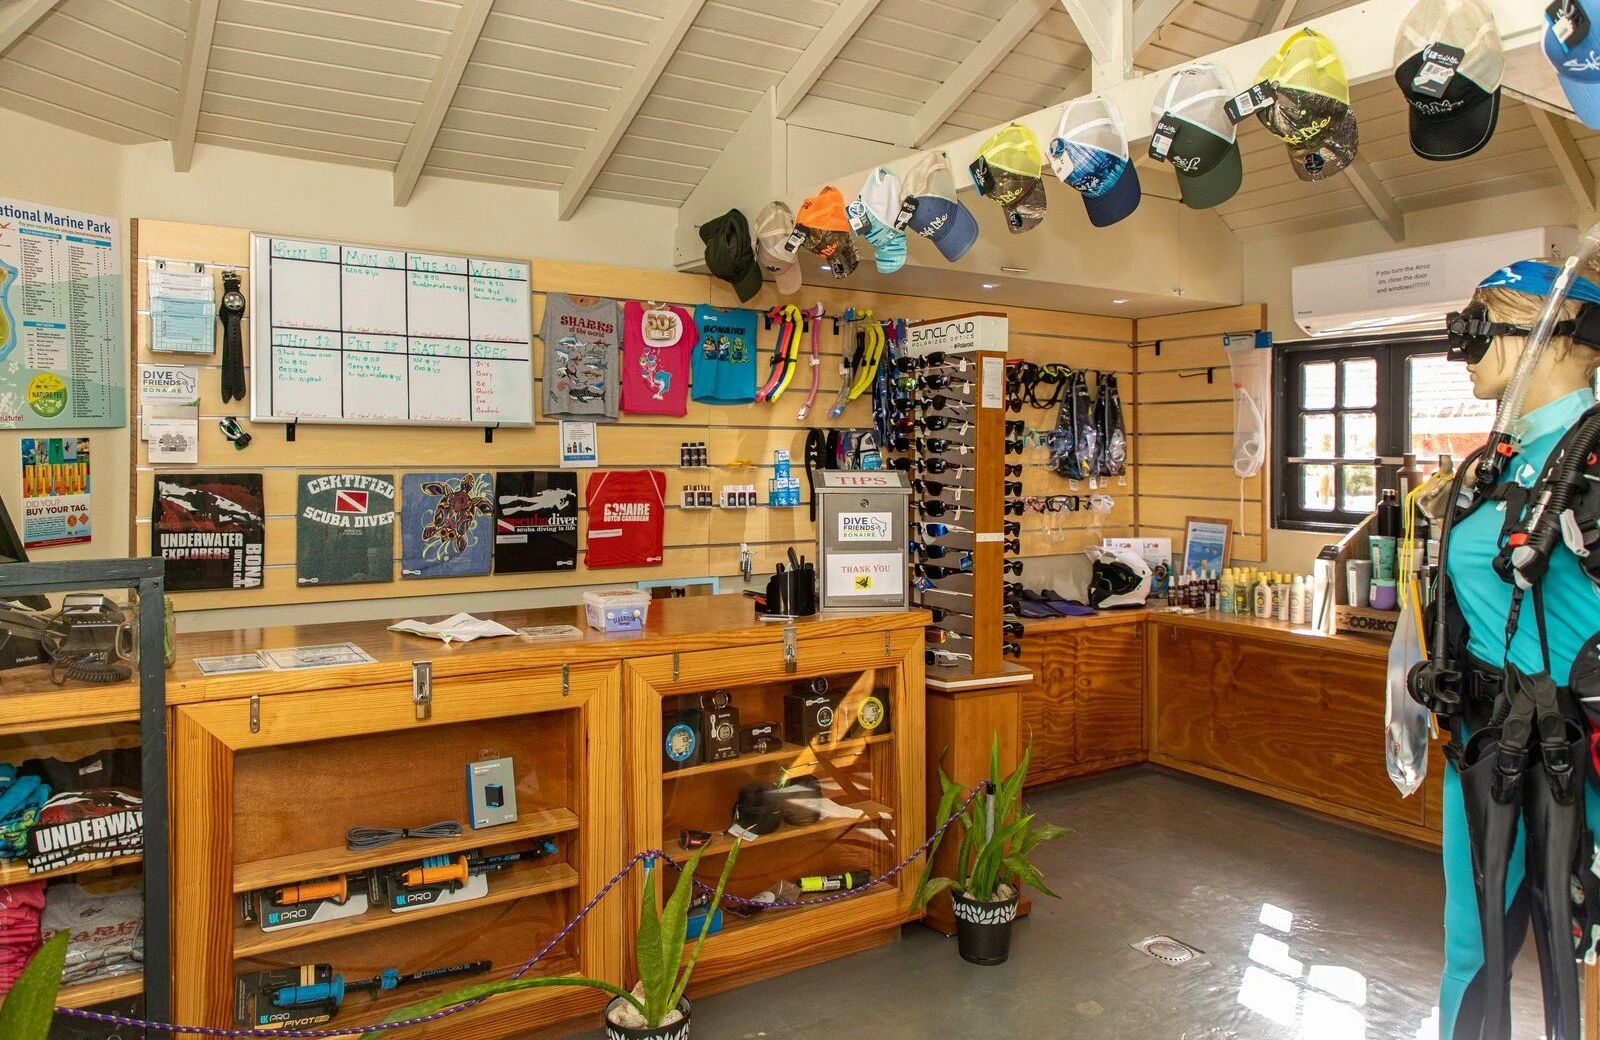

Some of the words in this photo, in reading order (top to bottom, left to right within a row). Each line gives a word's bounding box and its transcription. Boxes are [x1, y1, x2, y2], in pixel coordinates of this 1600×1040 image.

[44, 211, 84, 230] Marine
[87, 219, 111, 234] Park
[444, 263, 457, 273] 10
[560, 315, 614, 334] SHARKS
[703, 325, 747, 336] BONAIRE
[577, 326, 587, 335] the
[587, 330, 605, 338] world
[912, 321, 975, 342] SUNCLOUD
[912, 338, 947, 347] POLARIZED
[950, 333, 975, 342] OPTICS
[412, 340, 439, 356] SAT
[143, 371, 173, 380] DIVE
[306, 474, 394, 500] CERTIFIED
[835, 476, 888, 486] TIPS
[26, 508, 43, 516] BUY
[46, 506, 69, 514] YOUR
[70, 504, 88, 512] TAG.
[604, 502, 651, 516] BONAIRE
[302, 506, 351, 528] SCUBA
[354, 511, 395, 528] DIVER
[547, 512, 578, 526] diver
[843, 517, 868, 525] DIVE
[160, 533, 244, 548] UNDERWATER
[162, 547, 230, 560] EXPLORERS
[841, 565, 871, 573] THANK
[873, 564, 891, 573] YOU
[407, 891, 432, 903] PRO
[280, 908, 307, 921] PRO
[269, 1012, 290, 1022] PRO
[284, 1016, 316, 1028] PIVOT
